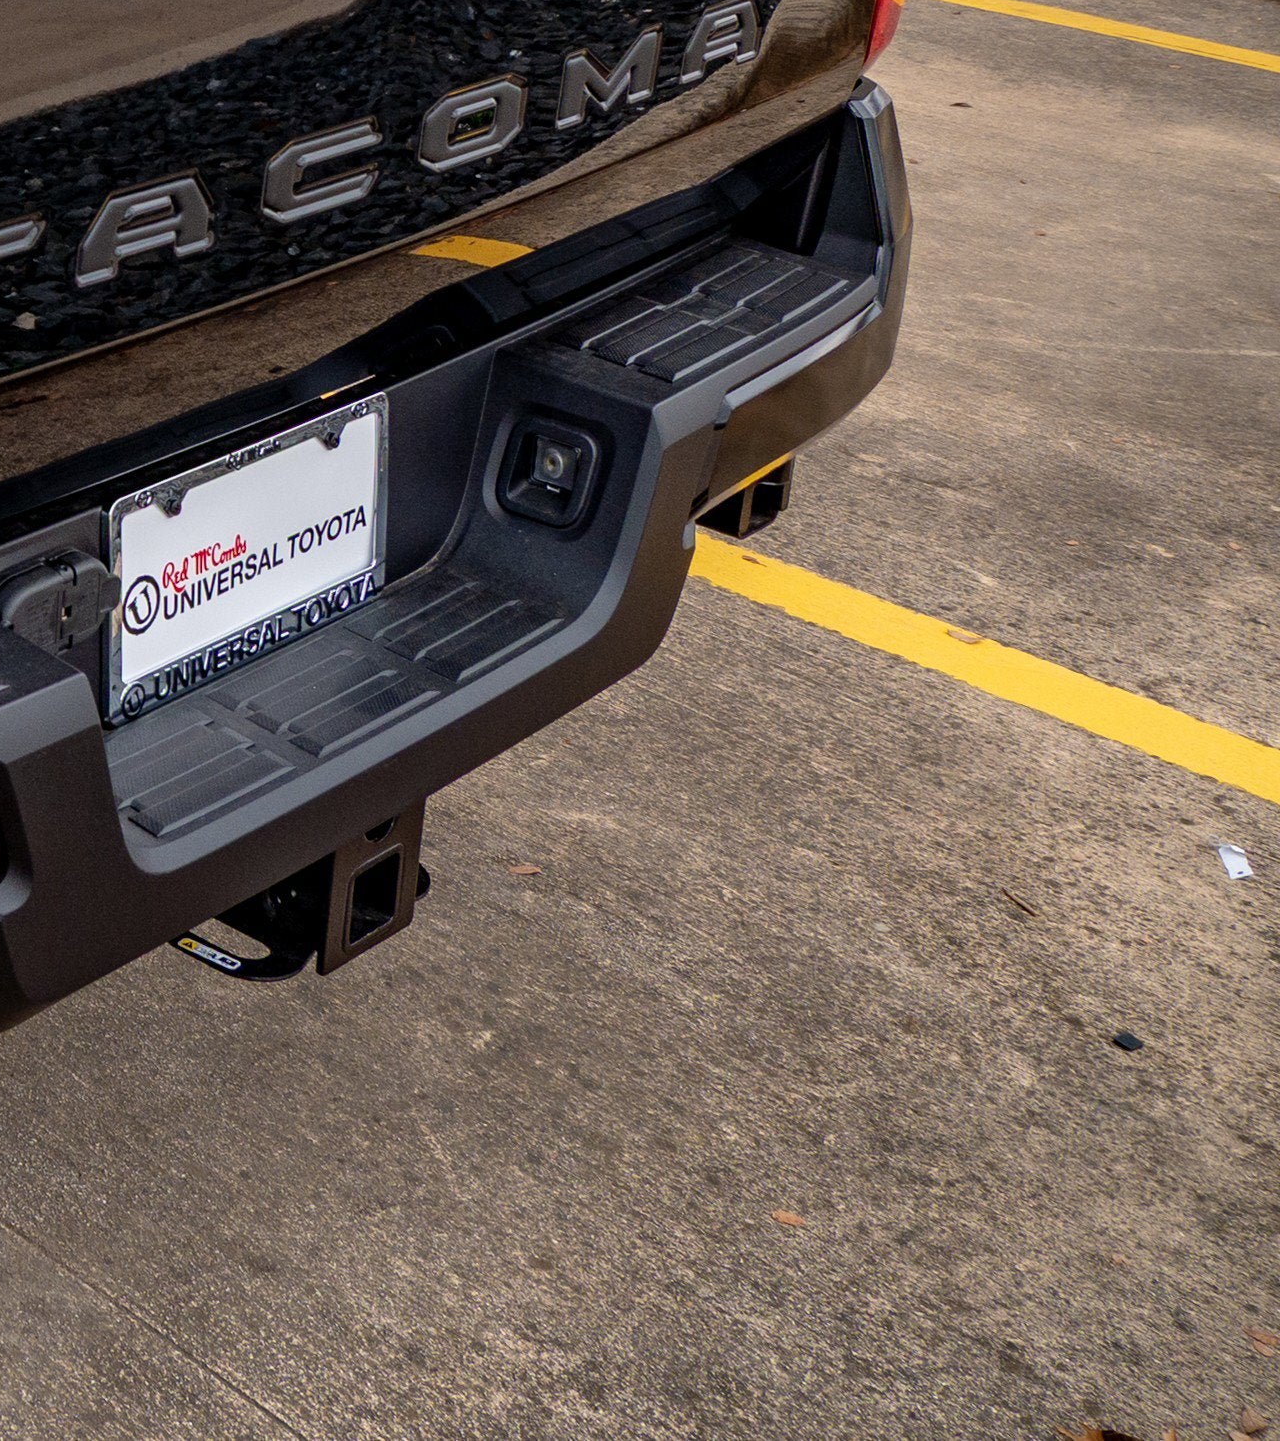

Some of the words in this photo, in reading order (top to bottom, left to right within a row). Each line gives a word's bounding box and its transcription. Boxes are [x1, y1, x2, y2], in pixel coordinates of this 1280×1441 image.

[162, 558, 189, 593] Red
[191, 534, 247, 575] McCombs
[163, 543, 283, 620] UNIVERSAL
[287, 505, 367, 559] TOYOTA
[154, 615, 289, 700] UNIVERSAL
[290, 572, 378, 628] TOYOTA
